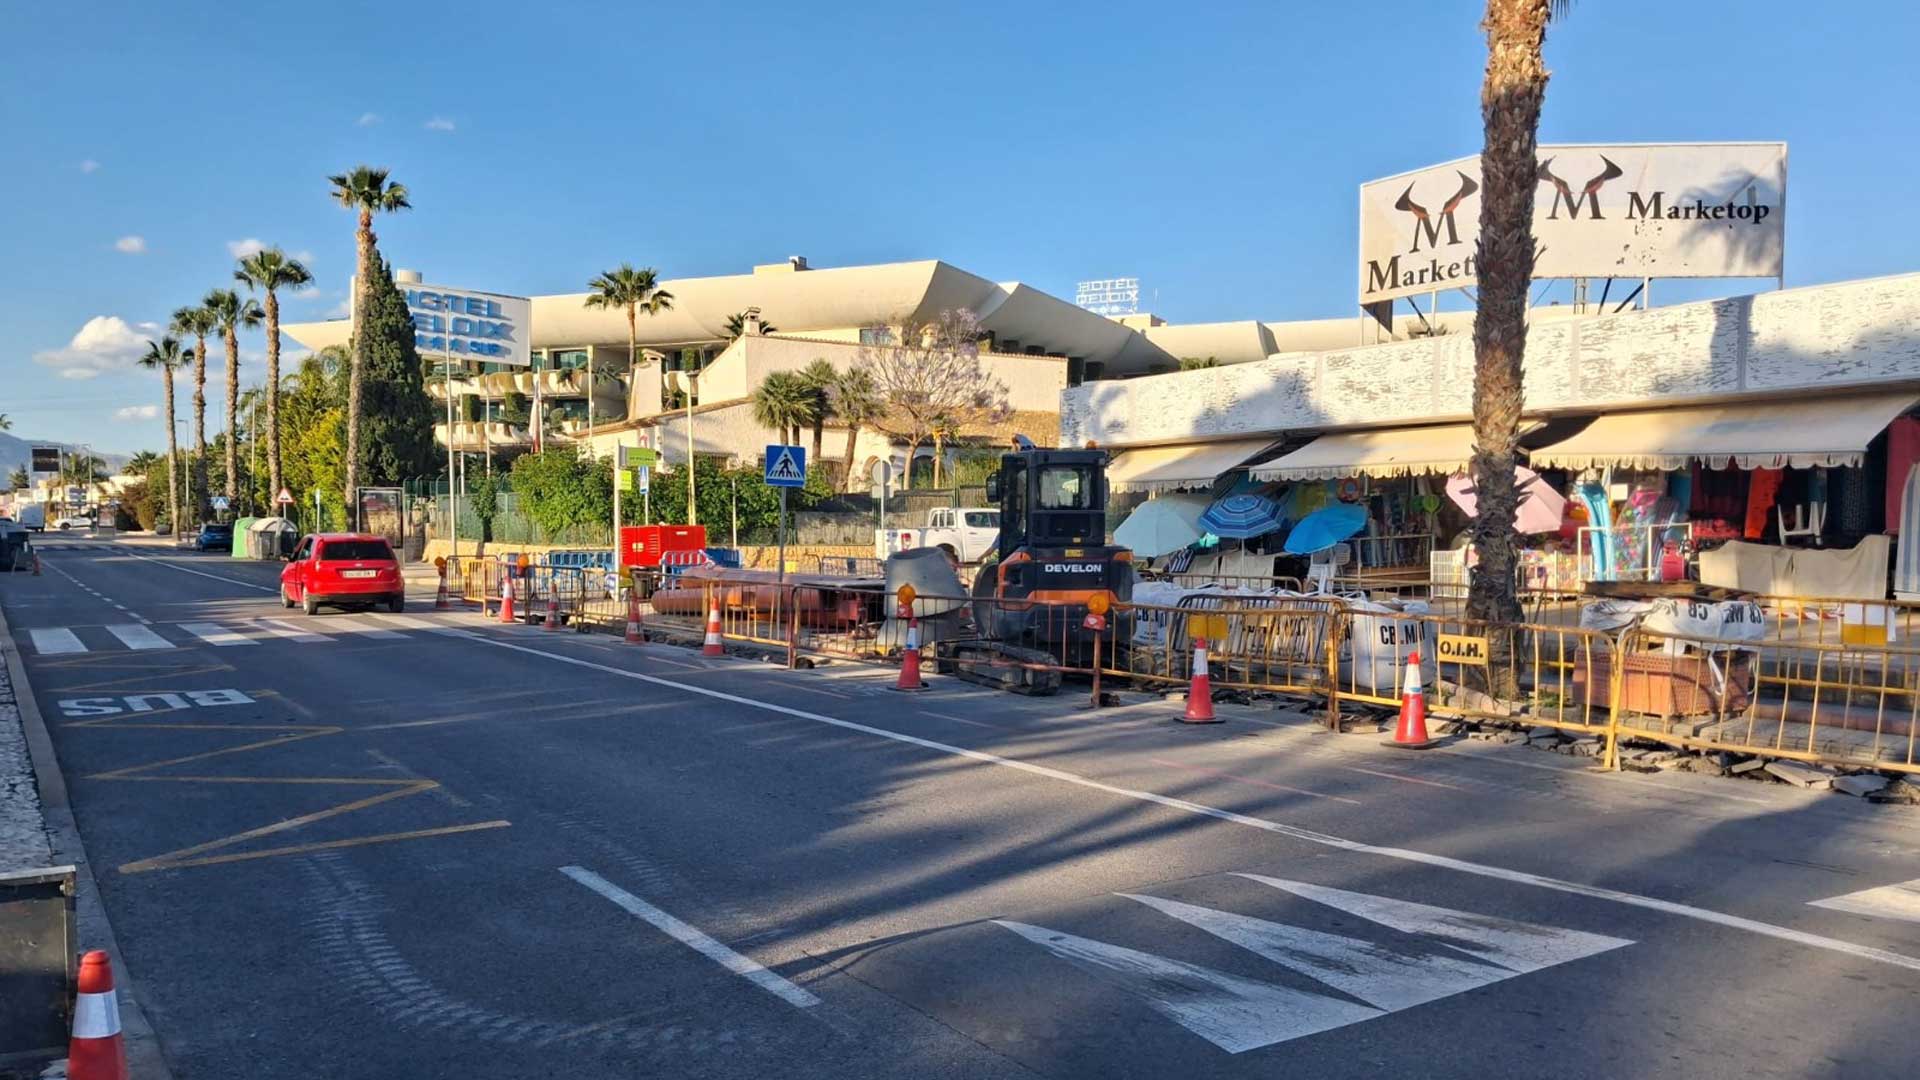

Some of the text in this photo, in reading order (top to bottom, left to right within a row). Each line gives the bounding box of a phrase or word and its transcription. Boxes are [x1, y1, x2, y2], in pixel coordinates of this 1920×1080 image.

[1625, 191, 1770, 224] Marketop
[1365, 254, 1477, 294] Market
[411, 311, 515, 342] ELOIX
[1045, 564, 1101, 573] DEVELON
[1440, 641, 1484, 658] O.I.H.
[58, 688, 256, 716] BUS
